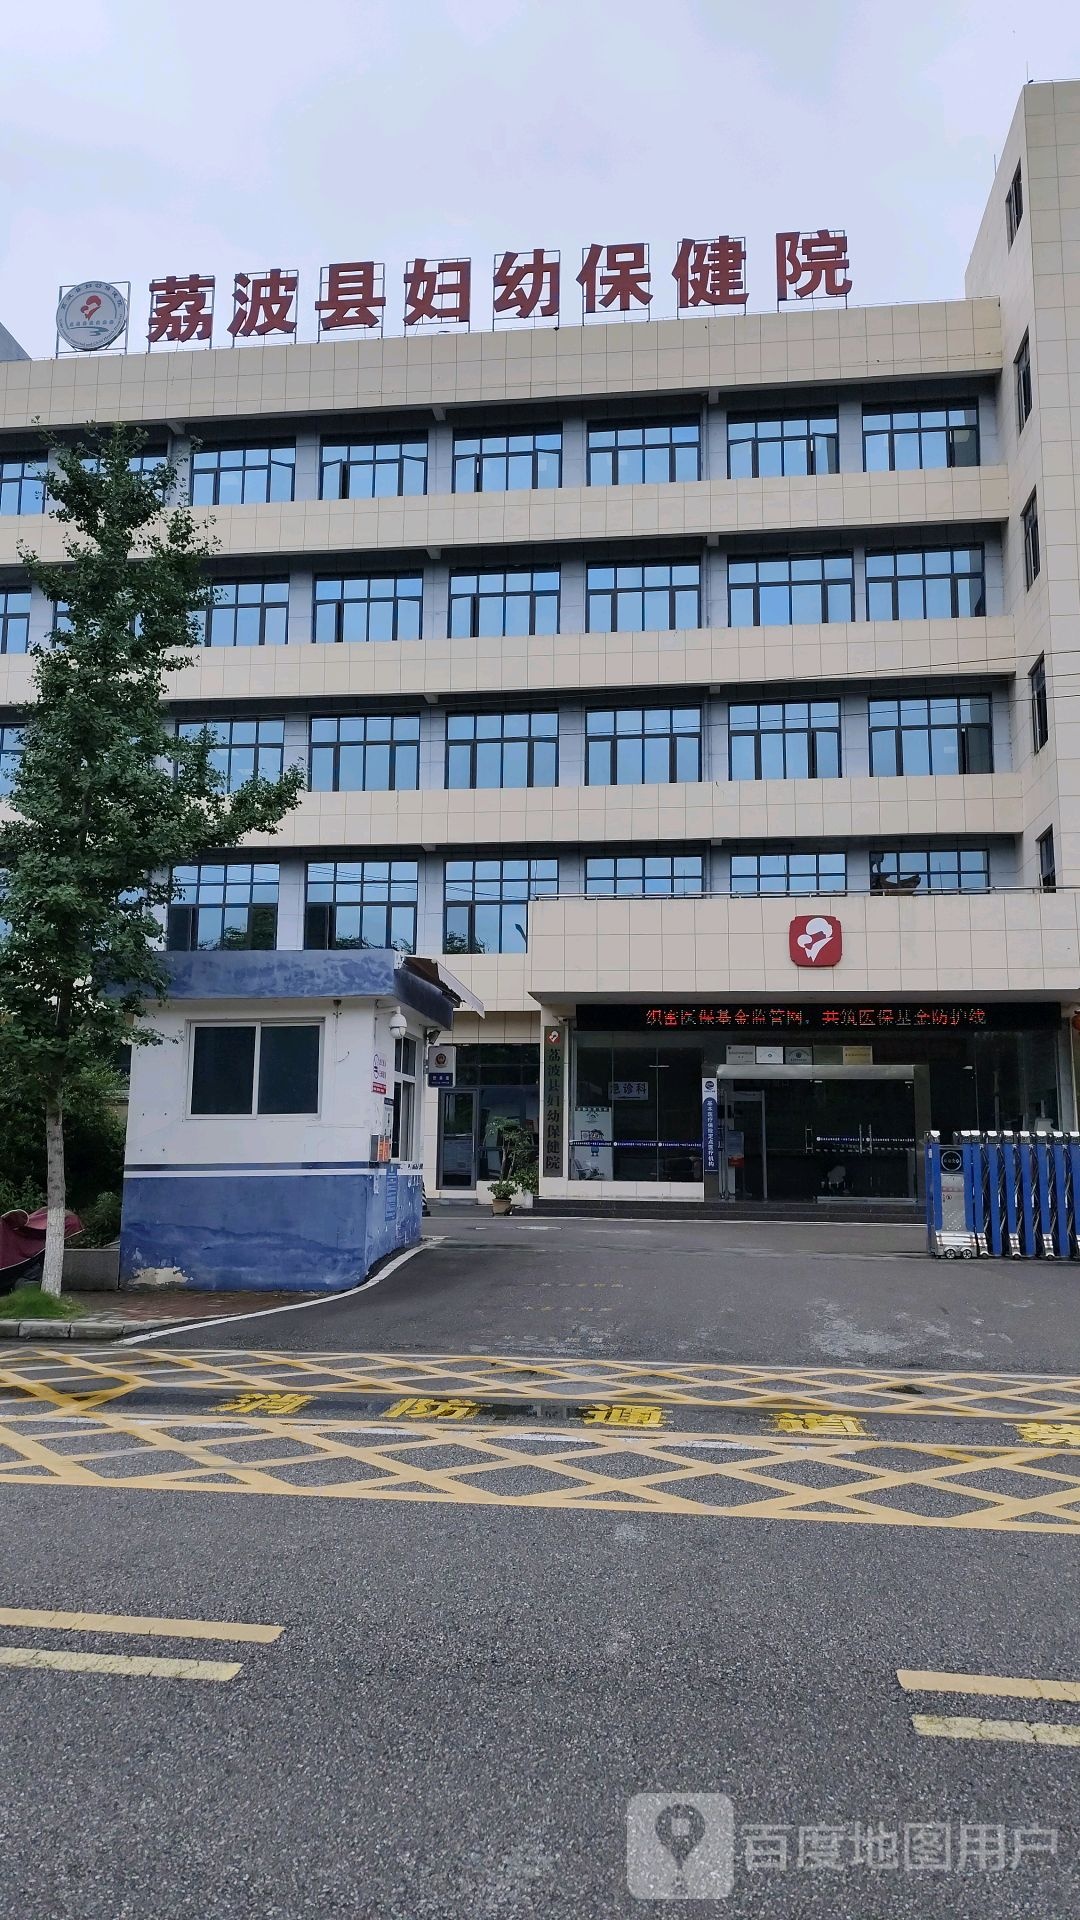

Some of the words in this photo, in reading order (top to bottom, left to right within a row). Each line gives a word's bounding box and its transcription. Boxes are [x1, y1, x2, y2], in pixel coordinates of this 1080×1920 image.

[147, 229, 853, 342] 荔波县妇幼保健院
[545, 1049, 561, 1170] 荔波县妇幼保健院
